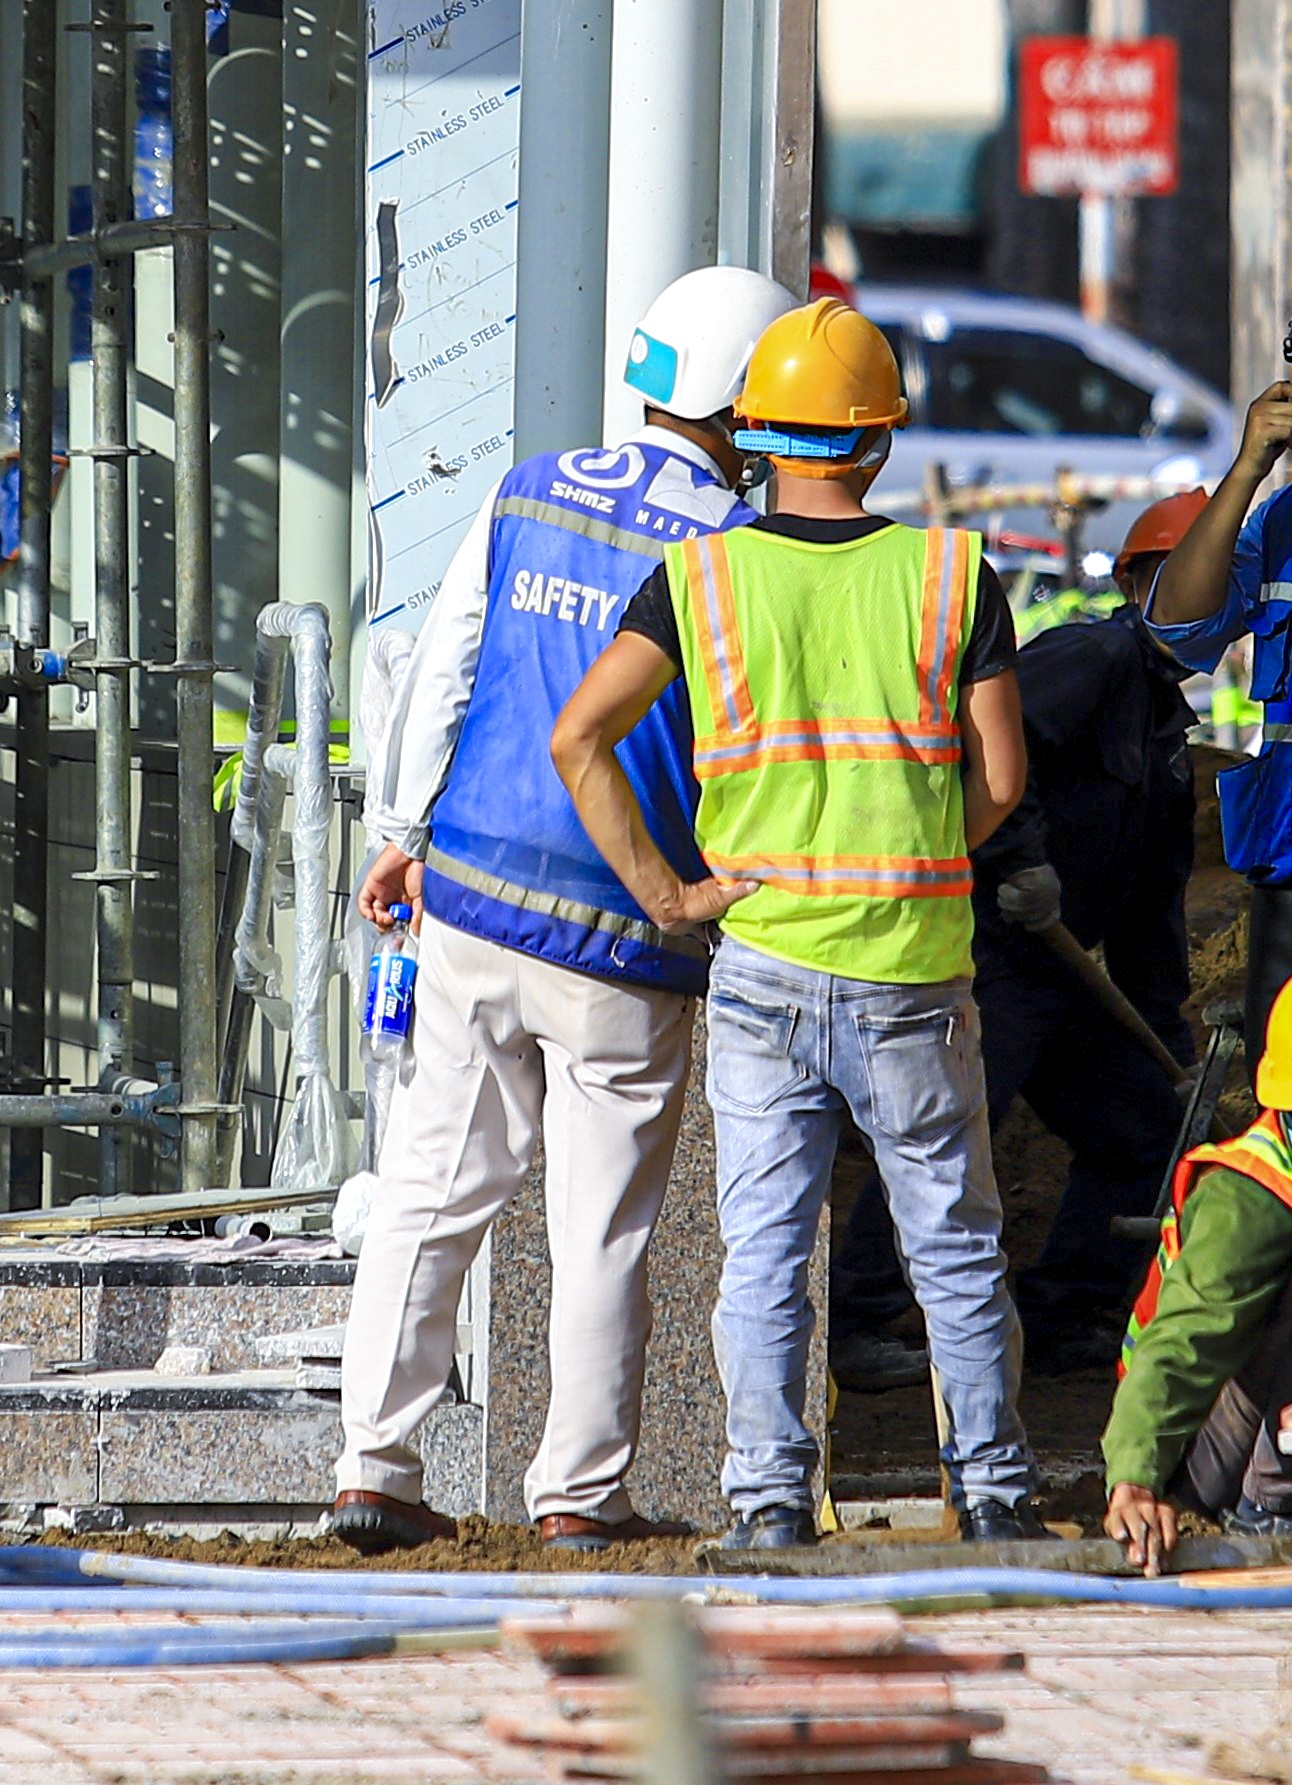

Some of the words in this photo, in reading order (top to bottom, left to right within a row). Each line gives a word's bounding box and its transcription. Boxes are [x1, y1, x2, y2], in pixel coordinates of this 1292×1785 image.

[406, 2, 467, 42] STAINLESS
[406, 114, 467, 156] STAINLESS
[469, 96, 504, 122] STEEL
[406, 229, 467, 270] STAINLESS
[470, 209, 505, 235] STEEL
[407, 342, 468, 383] STAINLESS
[471, 323, 505, 348] STEEL
[471, 435, 506, 461] STEEL
[635, 509, 698, 539] MAED
[407, 580, 442, 609] STAIN
[510, 569, 619, 631] SAFETY
